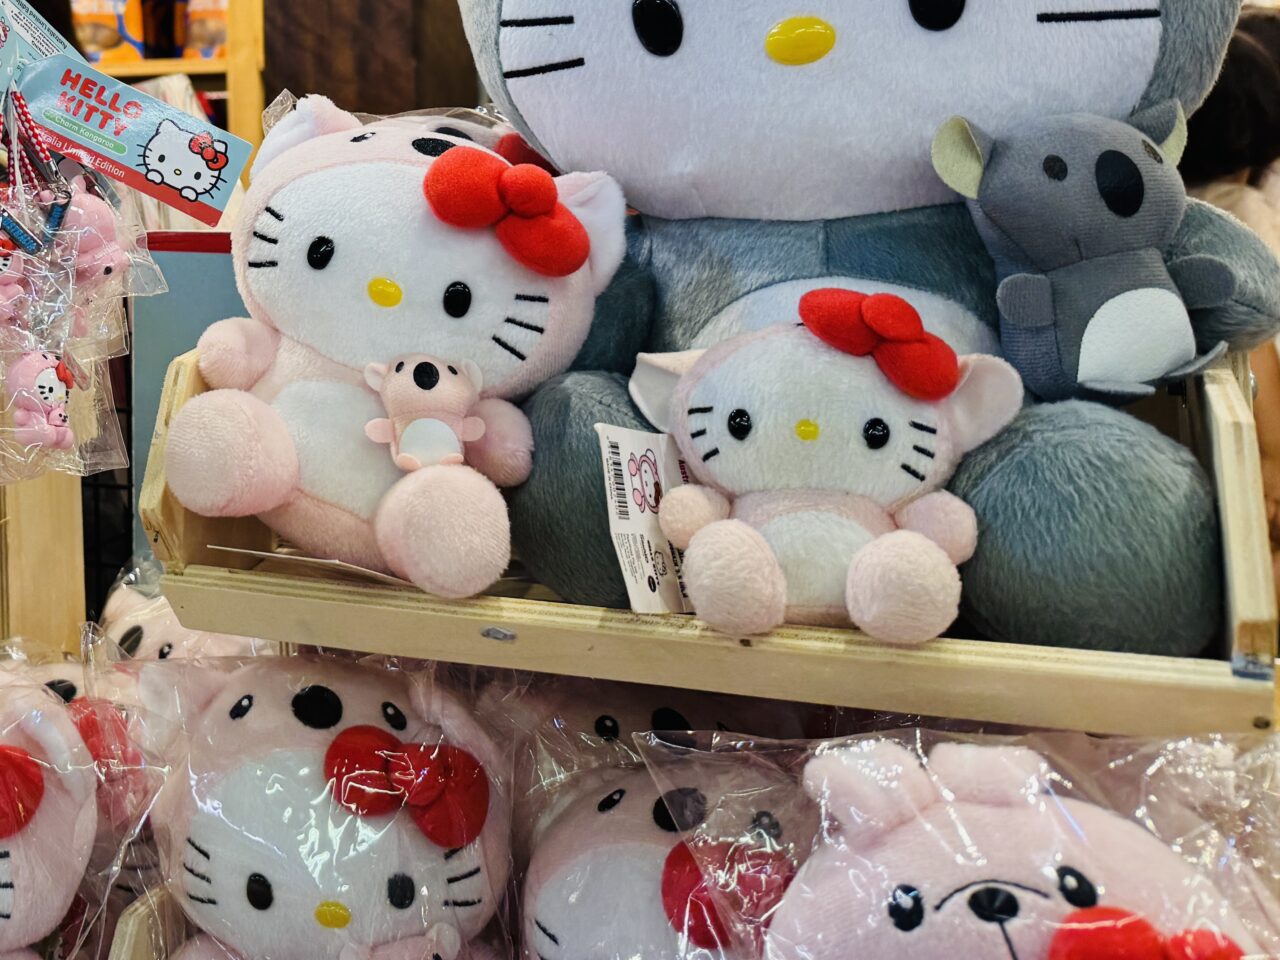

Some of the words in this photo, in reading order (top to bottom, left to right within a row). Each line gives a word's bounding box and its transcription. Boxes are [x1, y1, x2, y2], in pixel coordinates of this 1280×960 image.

[29, 11, 47, 31] Limited
[32, 40, 49, 57] ARNING
[45, 27, 67, 50] Australia
[60, 68, 143, 120] HELLO
[56, 91, 130, 137] KITTY
[55, 114, 79, 133] Charm
[79, 125, 114, 149] Kangaroo
[94, 157, 126, 179] Edition
